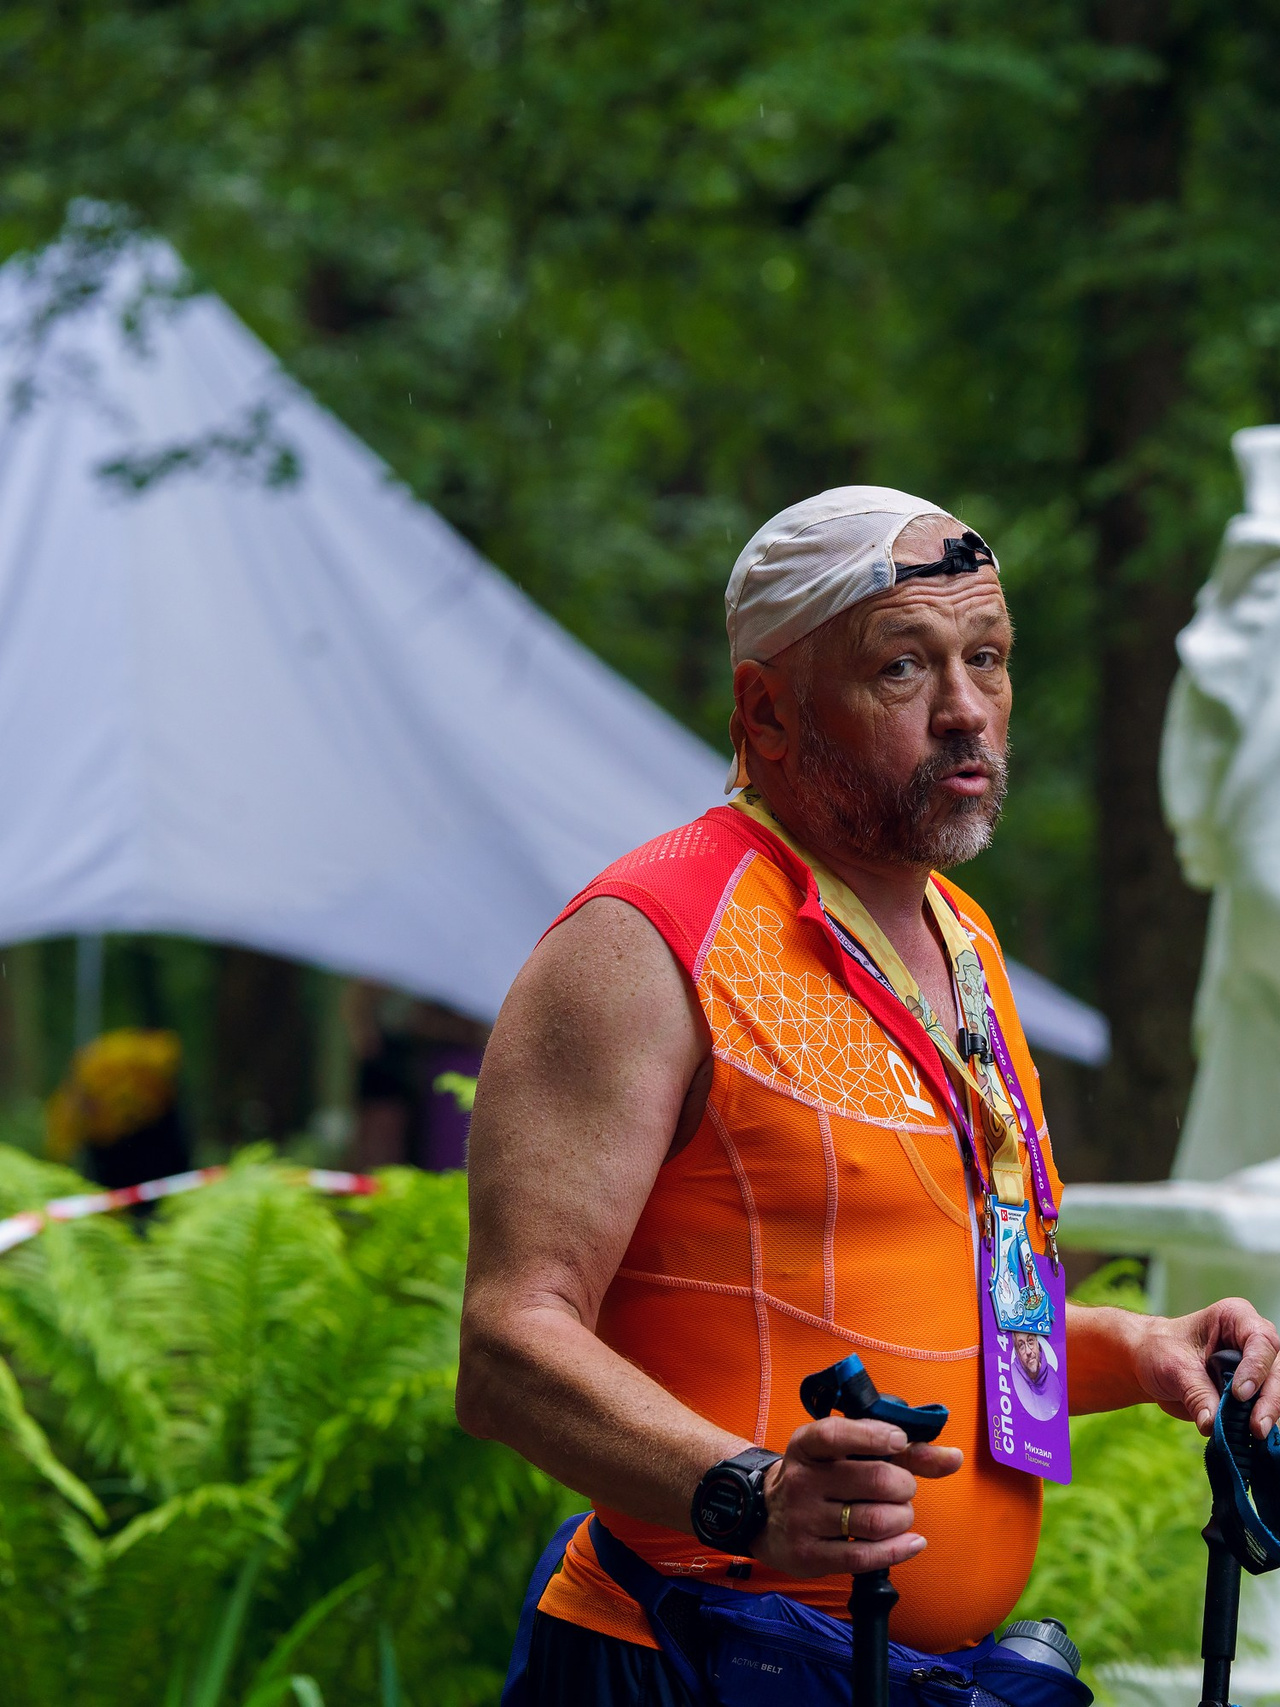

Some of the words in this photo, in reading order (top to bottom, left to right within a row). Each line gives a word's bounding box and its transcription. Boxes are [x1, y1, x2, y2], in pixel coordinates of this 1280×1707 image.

[987, 1016, 1002, 1052] СПОРТ
[998, 1052, 1007, 1066] 40
[1029, 1137, 1041, 1176] СПОРТ
[1037, 1177, 1045, 1190] 40
[996, 1331, 1009, 1352] 4
[997, 1355, 1015, 1455] СПОРТ
[1024, 1440, 1053, 1460] Михаил
[731, 1655, 760, 1670] ACTIVE
[760, 1662, 784, 1675] BELT
